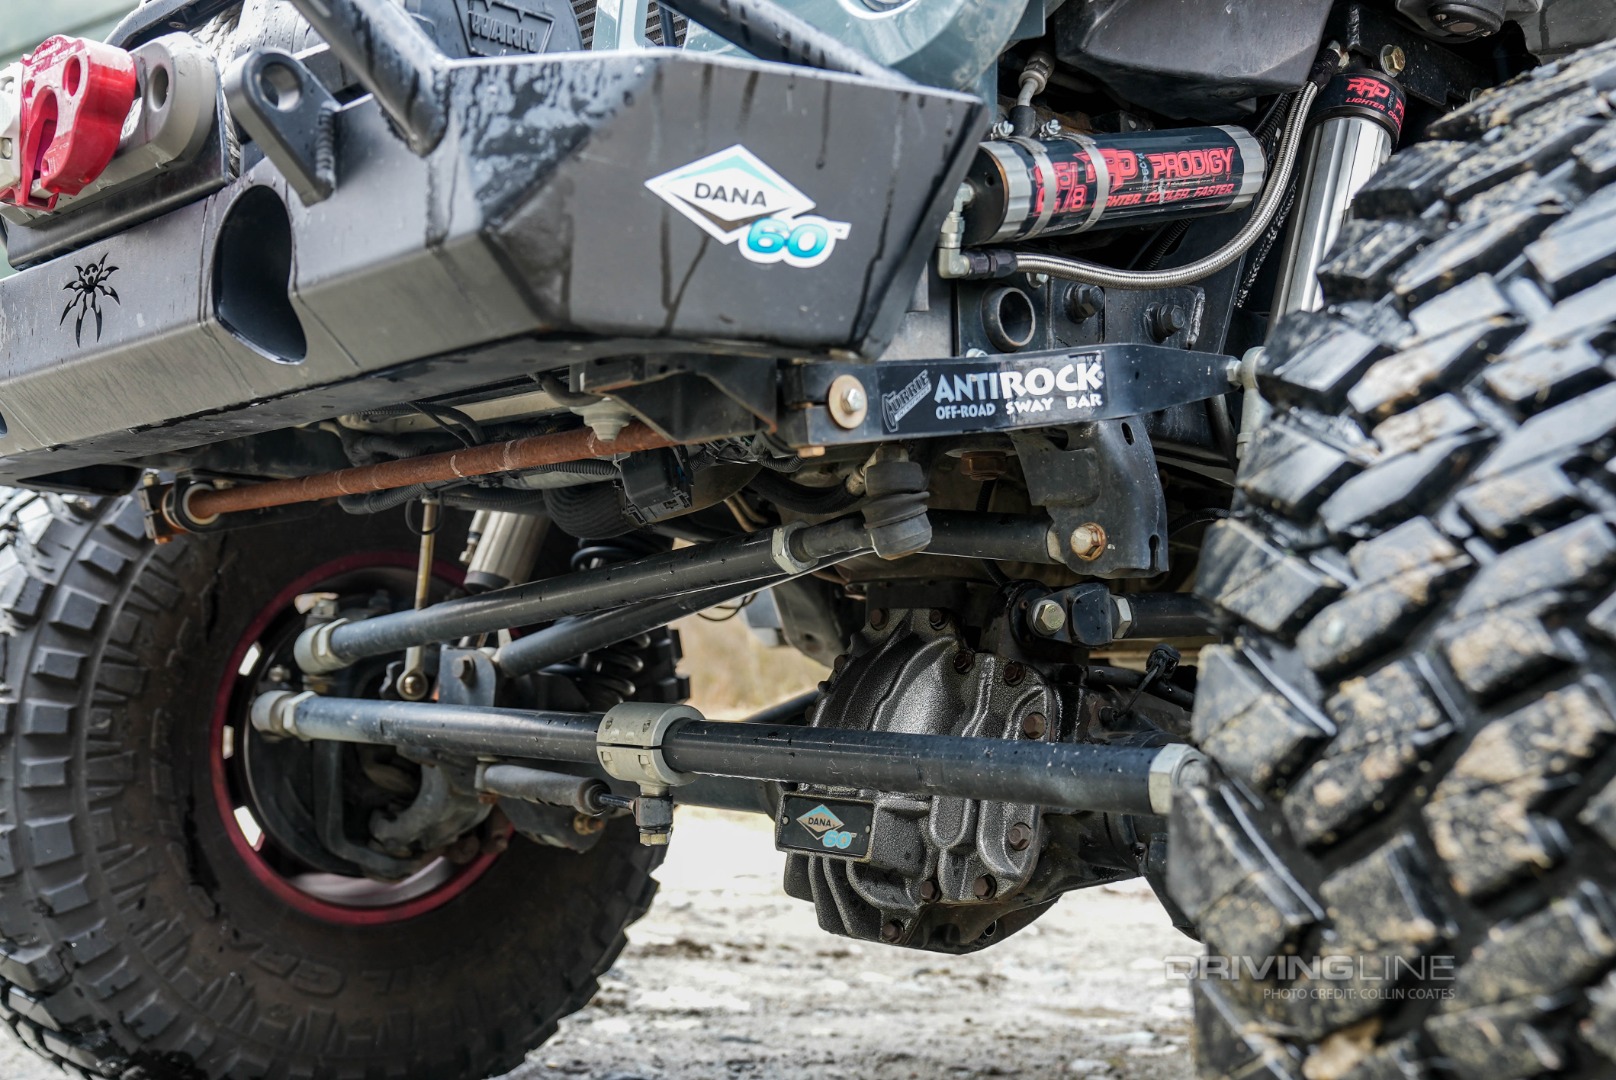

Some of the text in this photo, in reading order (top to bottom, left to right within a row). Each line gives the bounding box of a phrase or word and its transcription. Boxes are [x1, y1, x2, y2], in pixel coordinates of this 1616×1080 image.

[468, 11, 537, 53] WARN
[1147, 146, 1235, 180] PRODIGY
[694, 182, 767, 207] DANA
[747, 218, 828, 259] 60
[933, 362, 1106, 405] ANTIROCK
[935, 403, 996, 420] OFF-ROAD
[1005, 397, 1054, 415] SWAY
[1066, 393, 1103, 410] BAR
[808, 817, 832, 827] DANA
[822, 829, 852, 850] 60
